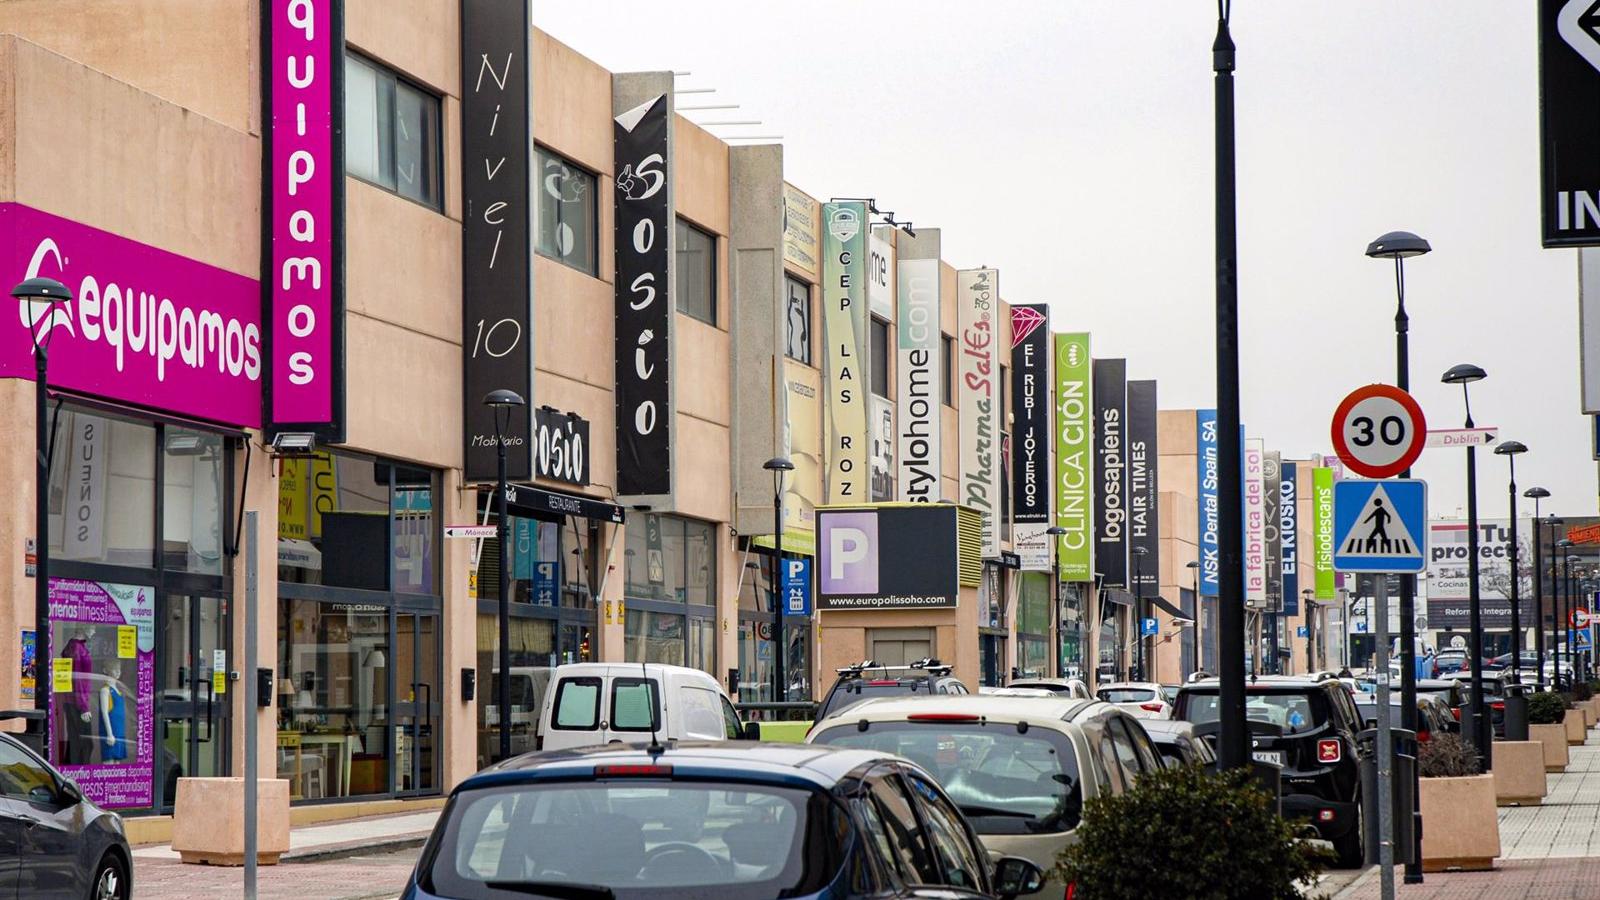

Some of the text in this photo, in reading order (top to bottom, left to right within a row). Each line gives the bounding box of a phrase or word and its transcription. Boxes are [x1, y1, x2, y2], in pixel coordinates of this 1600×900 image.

[472, 52, 521, 358] Nivel 10
[78, 275, 262, 381] equipamos
[630, 153, 664, 435] Sosio
[838, 251, 854, 496] CEP LAS ROZ
[471, 433, 523, 447] Mobiario
[534, 415, 583, 483] osio
[1024, 343, 1036, 508] EL RUBI JOYEROS
[1057, 380, 1086, 551] CLÍNICA CIÓN
[1351, 415, 1406, 447] 30
[548, 495, 582, 513] RESTAURANTE
[1101, 407, 1125, 543] logosapiens
[1132, 441, 1147, 537] HAIR TIMES
[1201, 420, 1219, 584] NSK Dental Spain SA
[1245, 448, 1262, 592] la fábrica del sol
[788, 561, 805, 579] P
[830, 527, 869, 580] P
[1281, 480, 1296, 575] EL KIOSKO
[1317, 487, 1333, 573] fisiodescans
[829, 594, 946, 607] www.europolissoho.com
[1146, 619, 1156, 630] P
